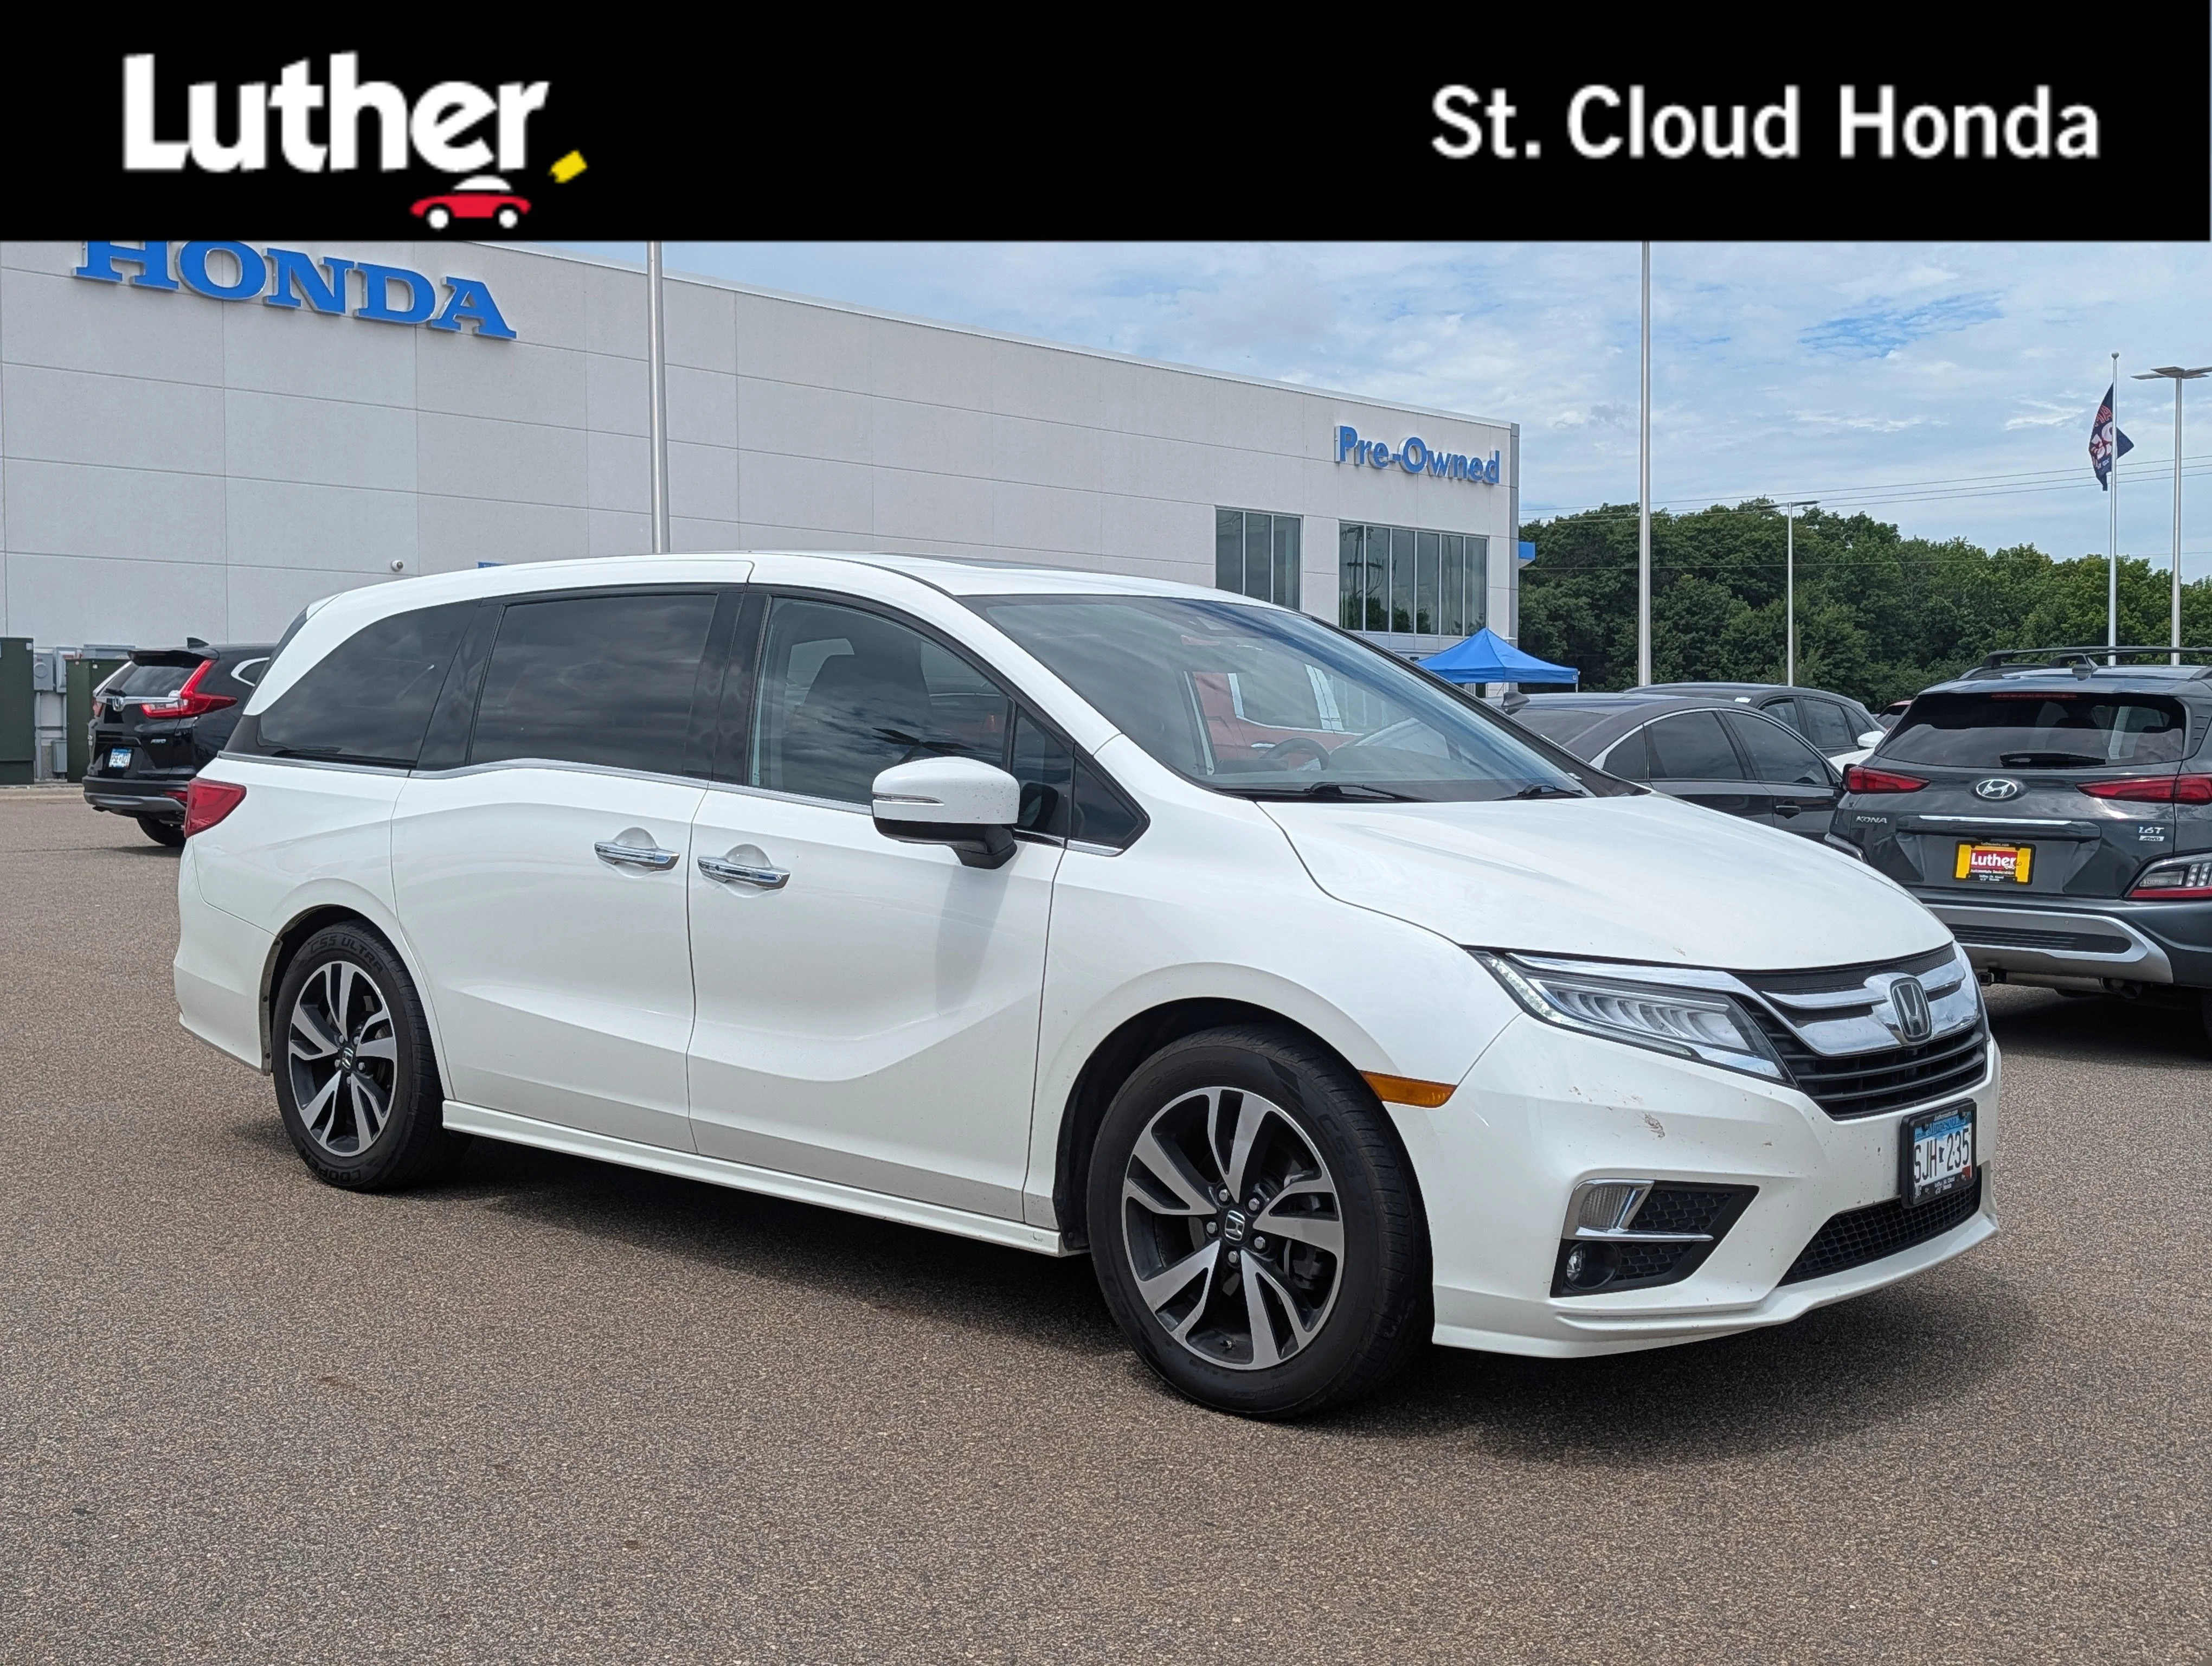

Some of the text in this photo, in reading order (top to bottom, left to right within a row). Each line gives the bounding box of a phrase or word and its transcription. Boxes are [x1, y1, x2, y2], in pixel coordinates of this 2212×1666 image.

[74, 241, 517, 339] HONDA
[1334, 425, 1500, 484] Pre-Owned
[1855, 816, 1887, 824] KONA
[1971, 853, 2016, 868] Luther
[341, 937, 384, 972] ULTRA
